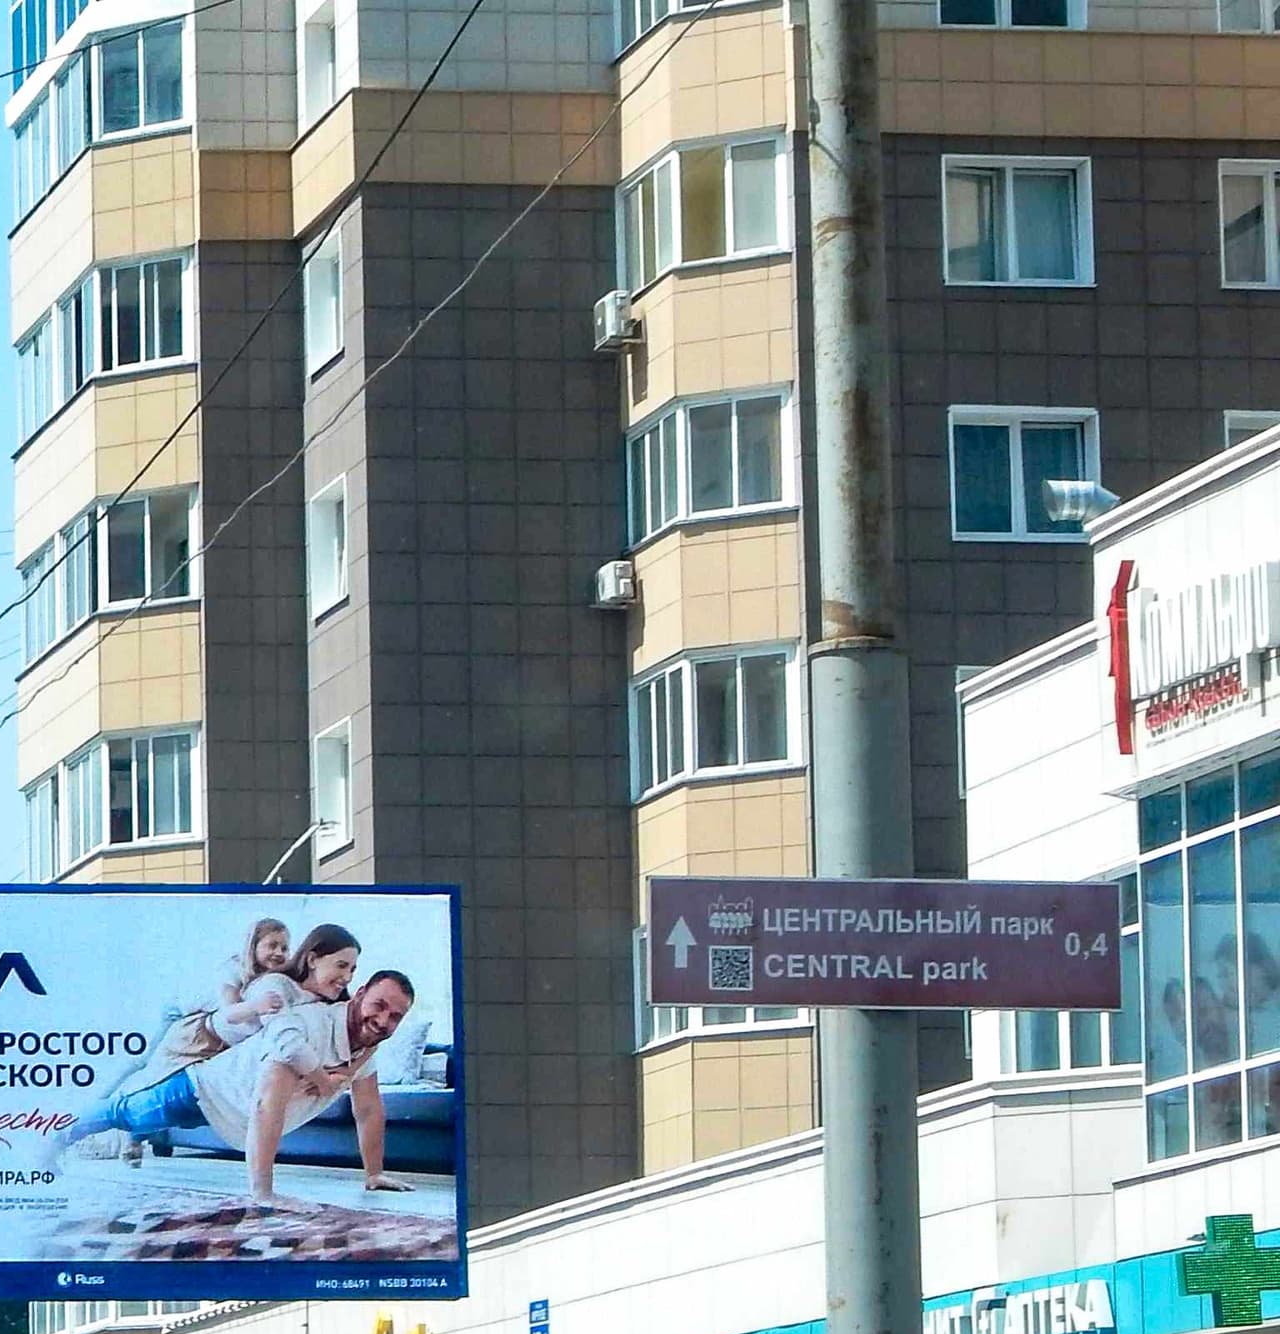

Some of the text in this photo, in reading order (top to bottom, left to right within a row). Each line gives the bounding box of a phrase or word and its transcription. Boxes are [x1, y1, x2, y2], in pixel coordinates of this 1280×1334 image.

[763, 904, 1054, 940] ЦЕНТРАЛЬНЫЙ парк
[1065, 932, 1109, 959] 0,4
[764, 955, 988, 984] CENTRAL park
